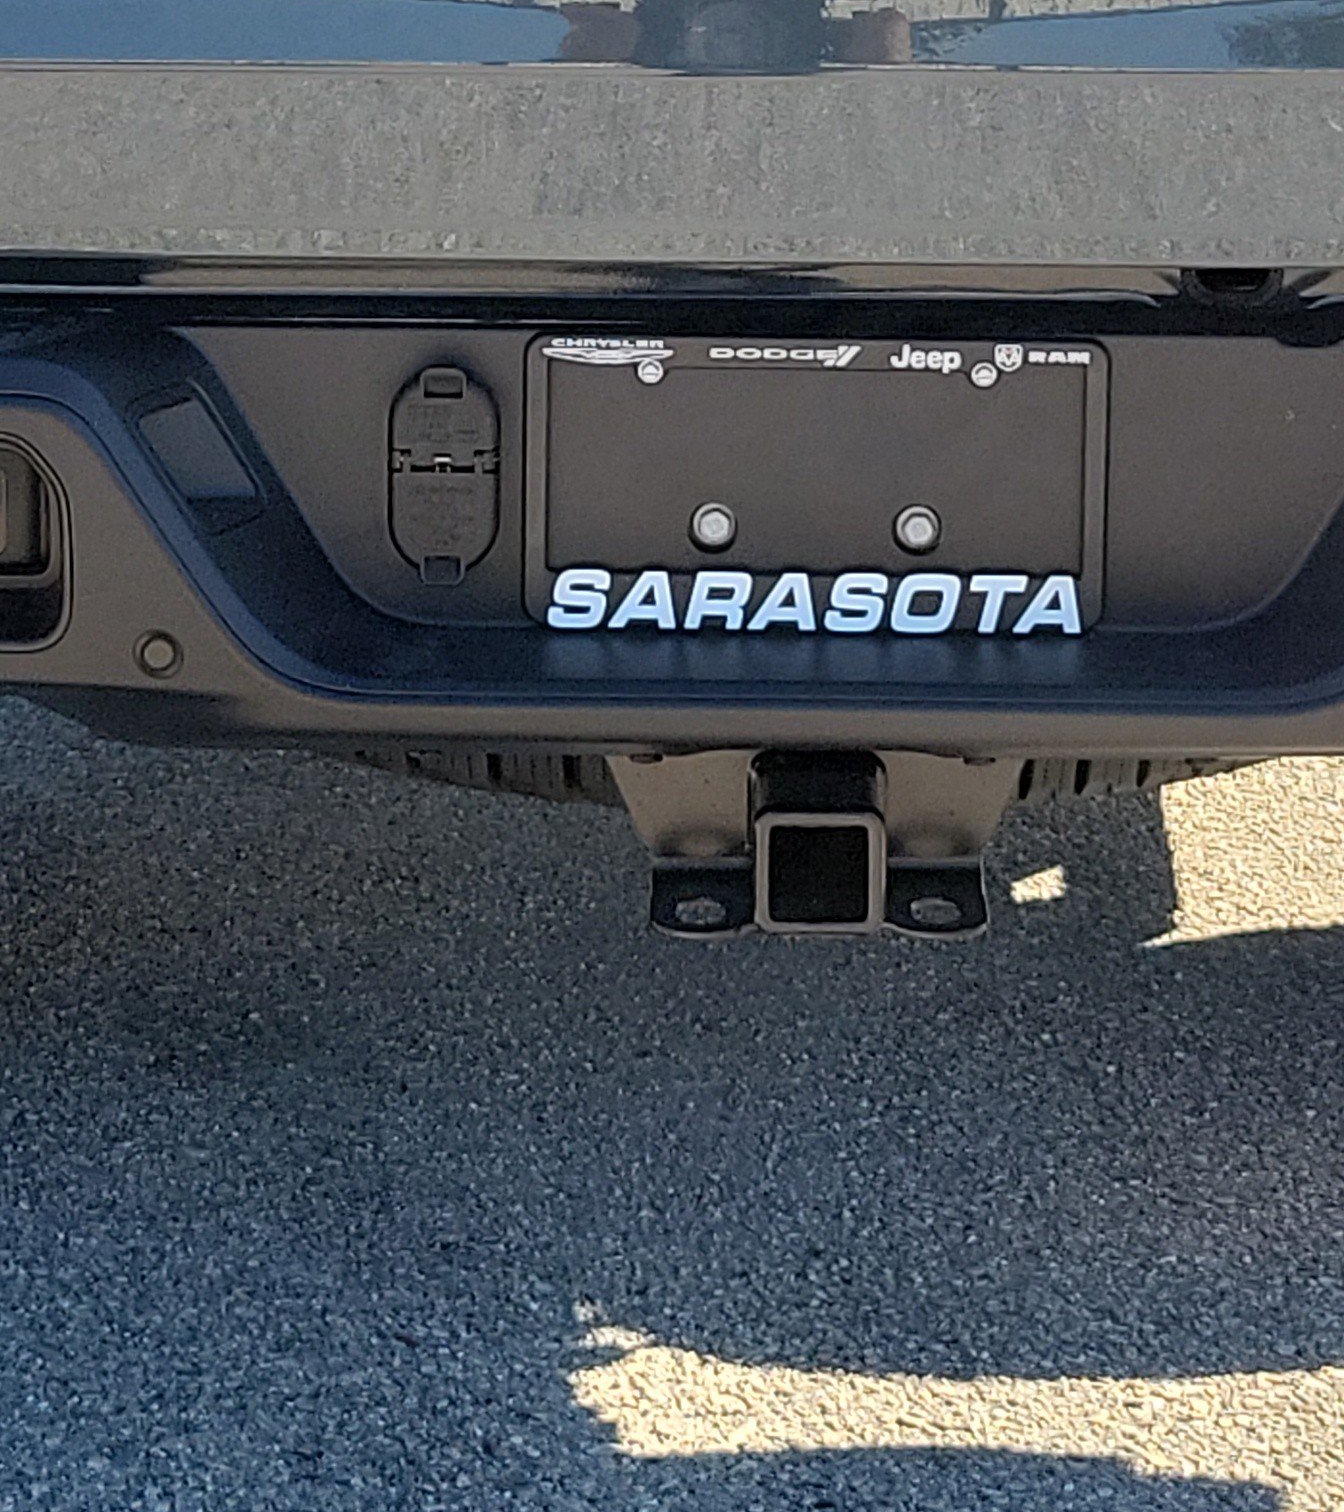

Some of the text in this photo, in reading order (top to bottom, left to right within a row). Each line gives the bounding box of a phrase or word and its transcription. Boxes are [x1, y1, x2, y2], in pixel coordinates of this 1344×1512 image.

[550, 337, 665, 349] CHRYSLER
[709, 346, 838, 361] DODGE
[890, 344, 962, 374] Jeep
[1027, 351, 1092, 365] RAM
[547, 568, 1082, 635] SARASOTA
